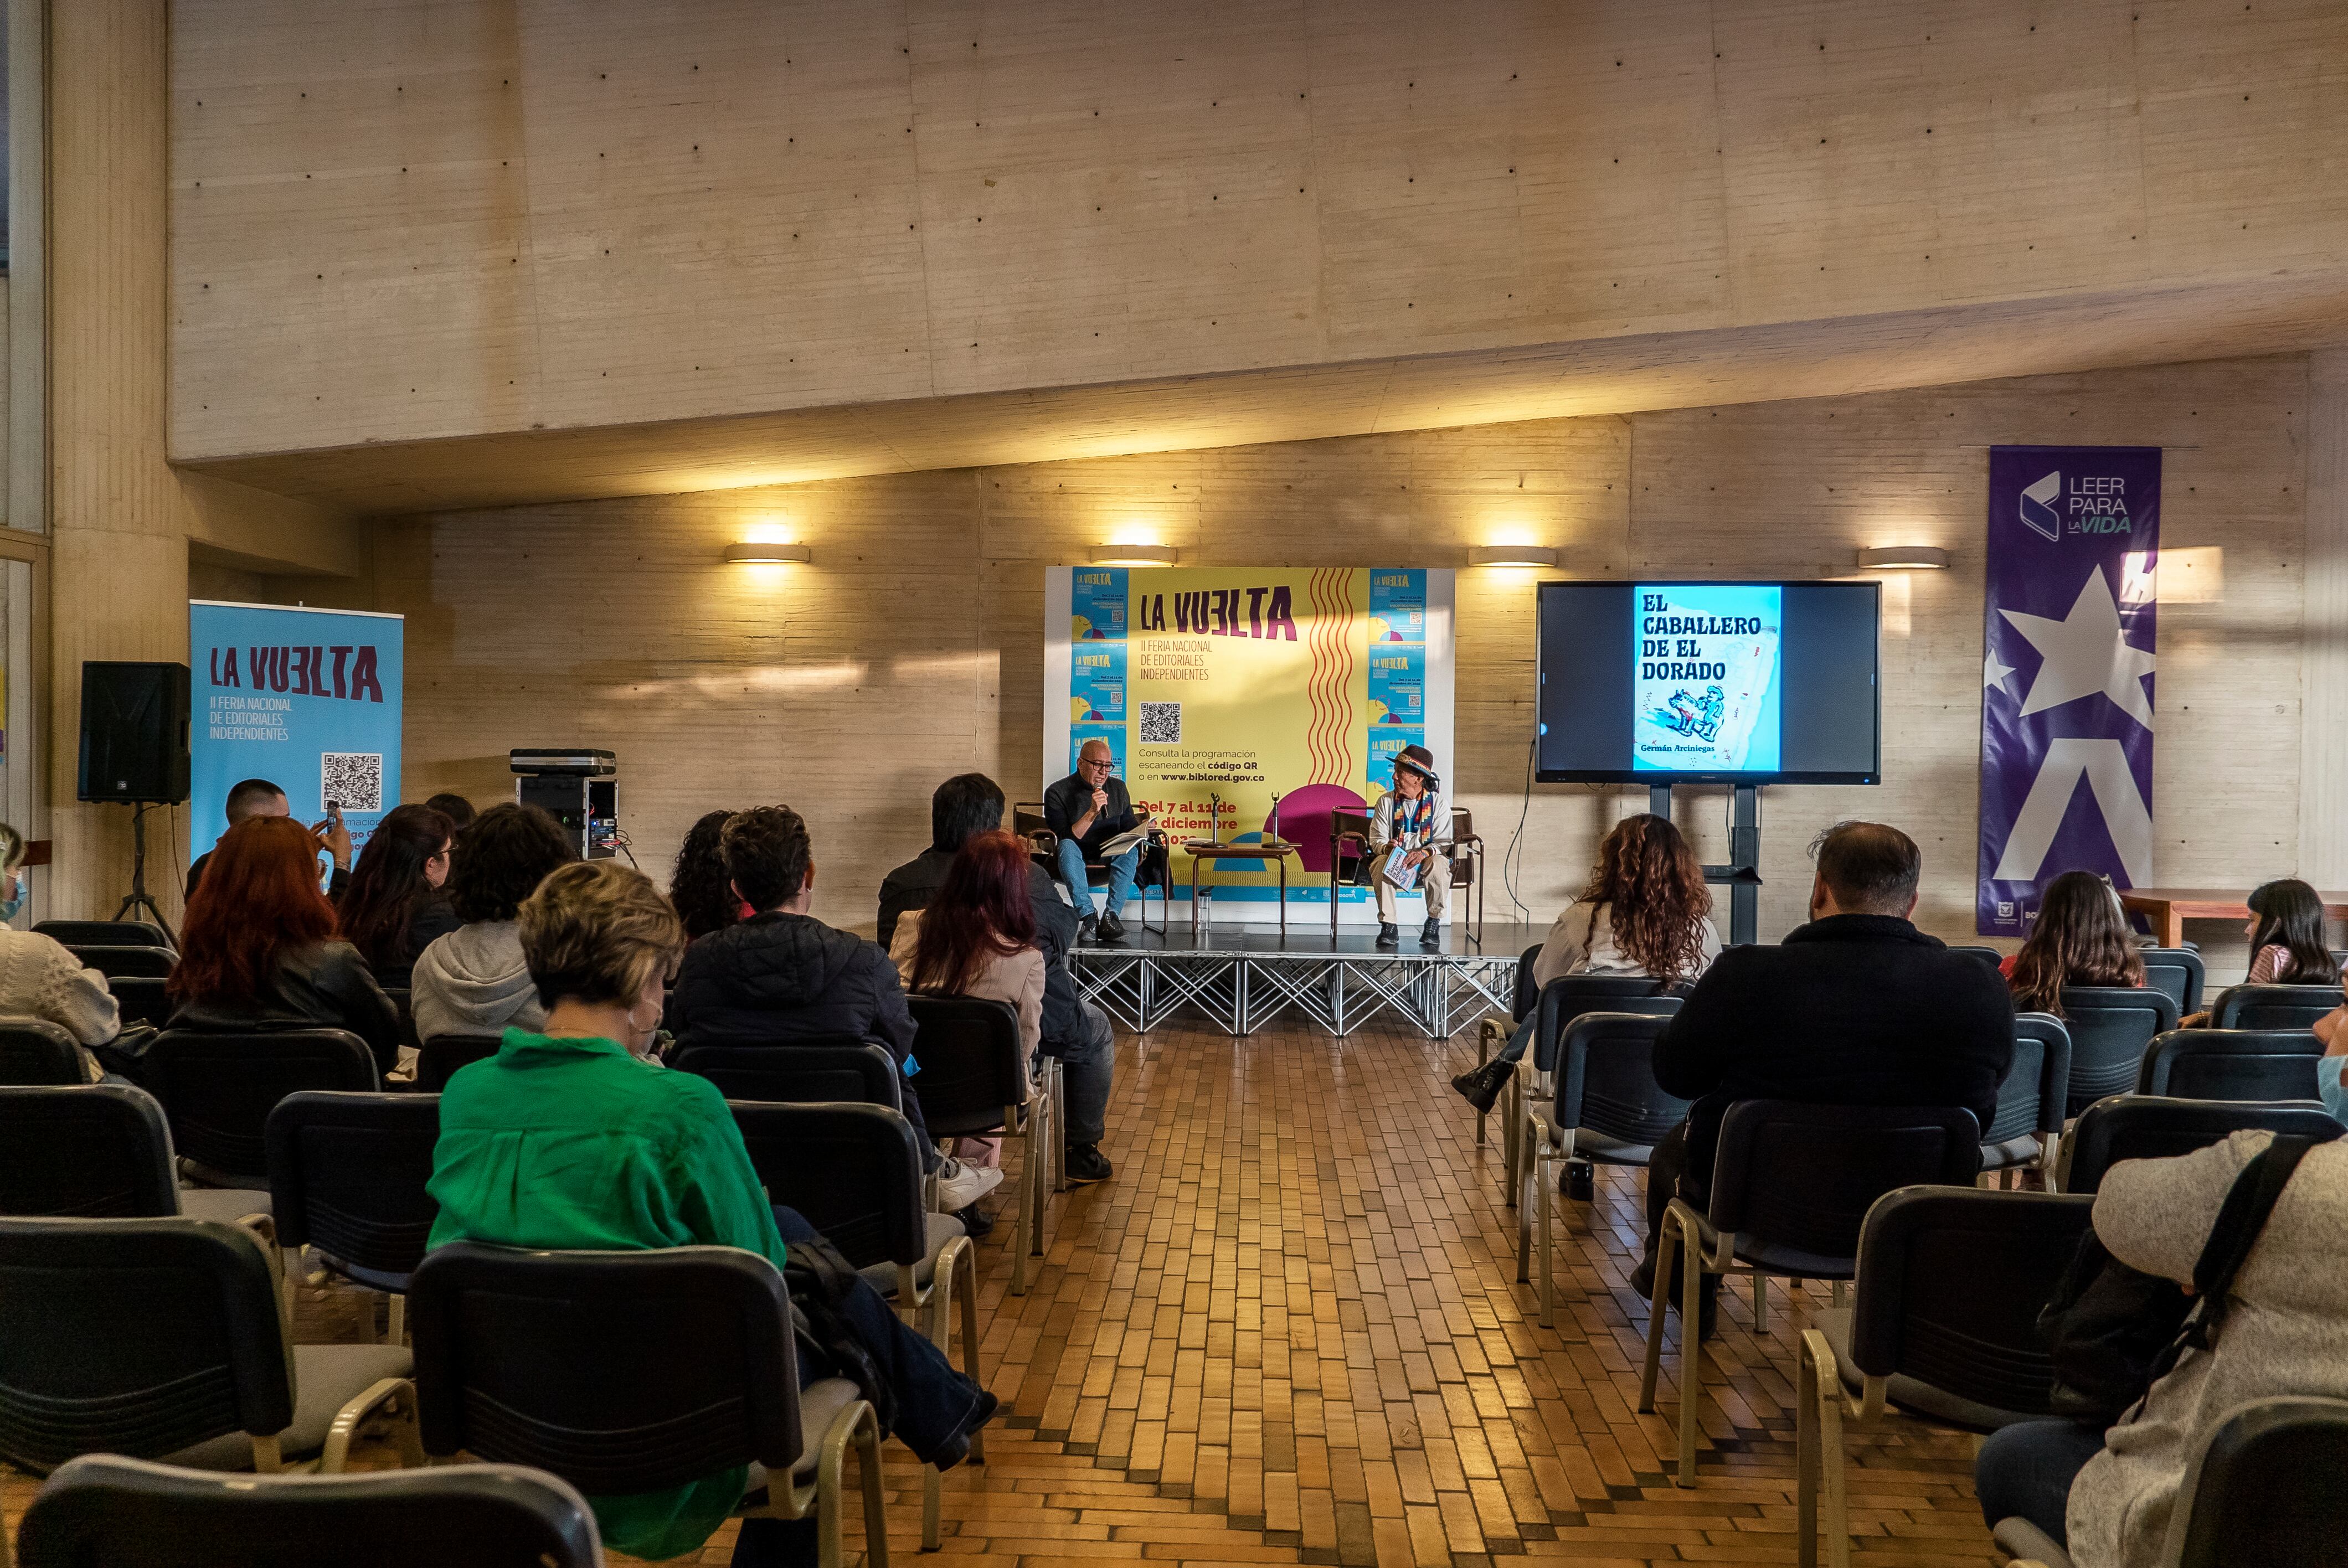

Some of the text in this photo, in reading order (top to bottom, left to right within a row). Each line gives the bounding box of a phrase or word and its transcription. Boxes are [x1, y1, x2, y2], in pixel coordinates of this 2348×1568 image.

[2070, 477, 2125, 494] LEER
[2069, 498, 2128, 515] PARA
[2068, 516, 2131, 534] LA VIDA
[1642, 594, 1668, 612] EL
[1141, 585, 1297, 641] LA VUELTA
[1643, 617, 1762, 635] CABALLERO
[1141, 640, 1213, 652] II FERIA NACIONAL
[1642, 639, 1701, 657] DE EL
[1141, 654, 1204, 666] DE EDITORIALES
[210, 646, 384, 703] LA VUELTA
[1141, 668, 1209, 680] INDEPENDIENTES
[1642, 662, 1726, 680] DORADO
[210, 697, 292, 711] II FERIA NACIONAL
[210, 711, 283, 725] DE EDITORIALES
[210, 726, 289, 741] INDEPENDIENTES
[1139, 749, 1255, 760] Consulta la programación
[1674, 745, 1715, 753] Arciniegas
[1208, 761, 1241, 771] código
[1161, 773, 1265, 783] www.biblored.gov.co
[1139, 801, 1237, 814] Del 7 al 11 de
